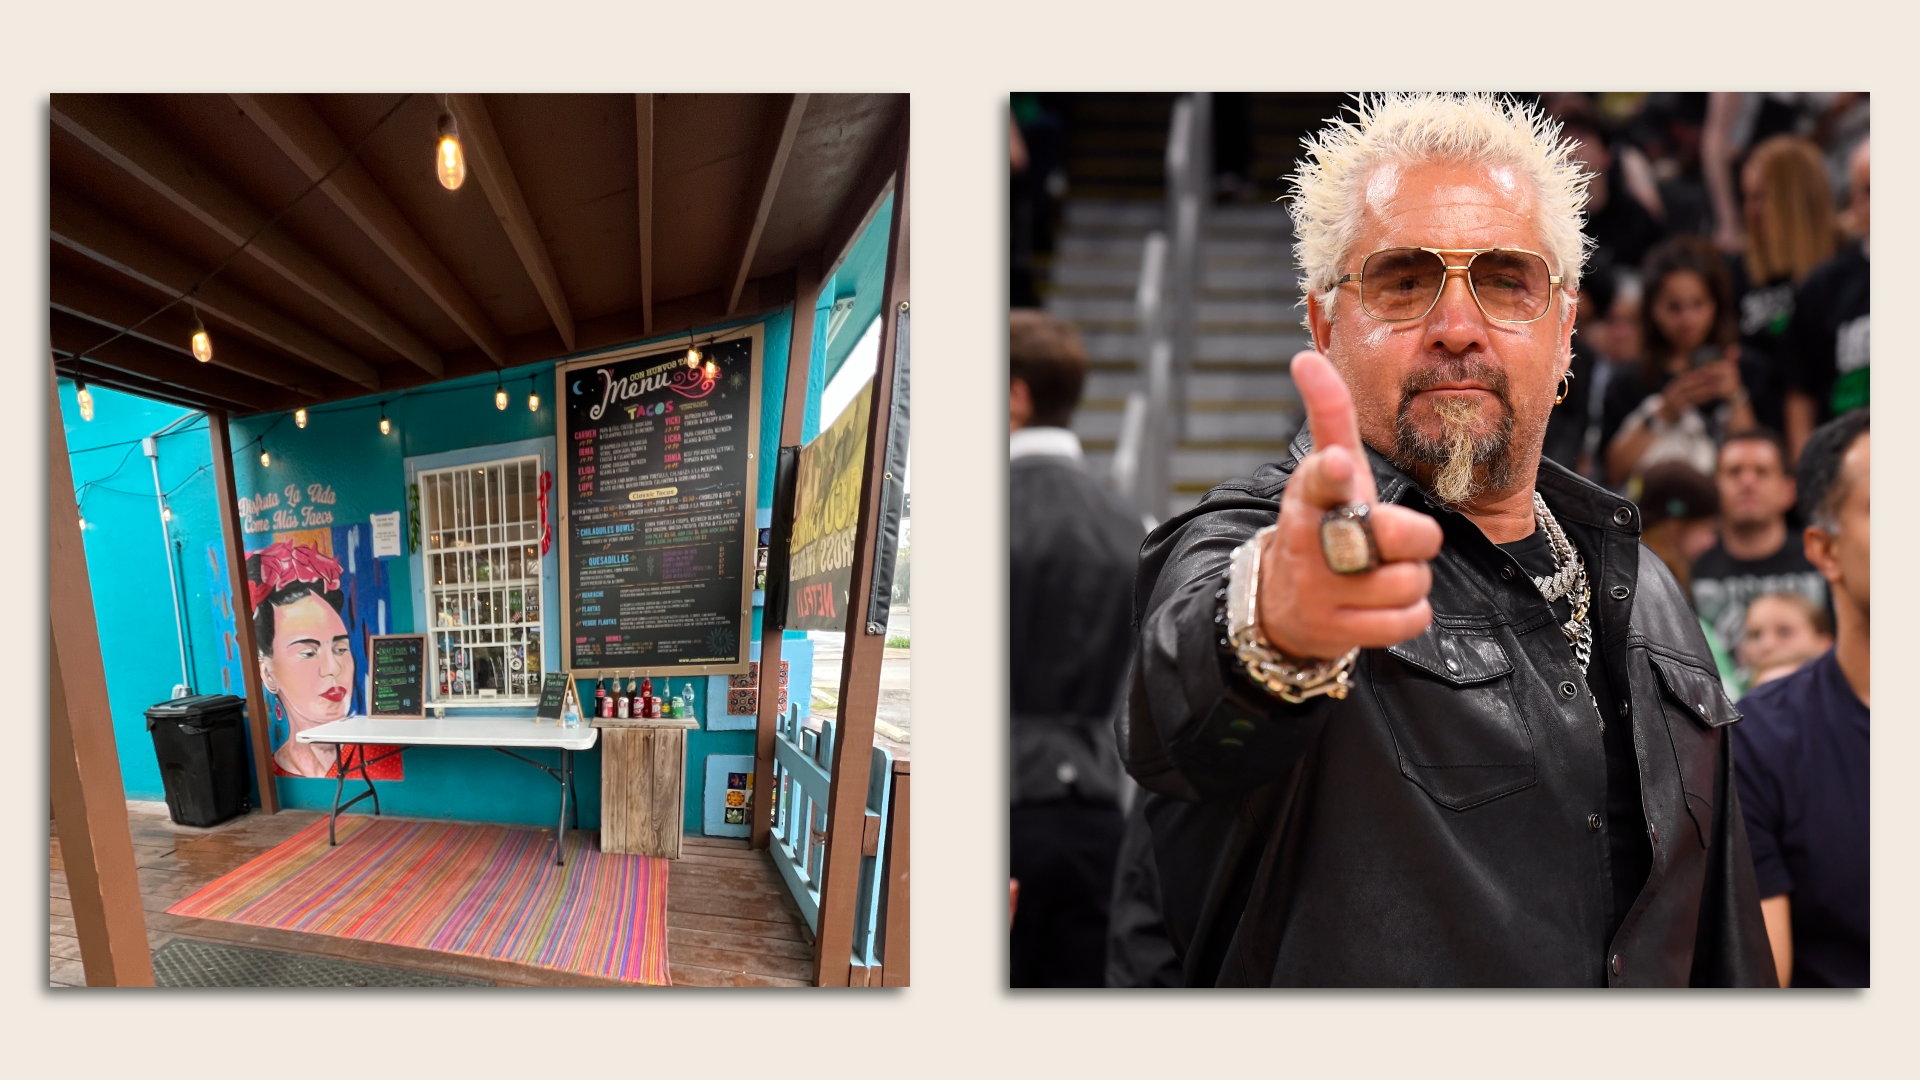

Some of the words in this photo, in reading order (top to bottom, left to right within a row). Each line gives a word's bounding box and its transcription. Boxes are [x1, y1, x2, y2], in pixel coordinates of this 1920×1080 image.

[630, 371, 645, 382] CON
[647, 361, 677, 377] HUEVOS
[589, 368, 672, 420] Menu
[628, 400, 673, 420] TACOS
[664, 415, 680, 426] VICKI
[574, 428, 596, 440] CARMEN
[664, 433, 681, 444] LICHA
[663, 452, 681, 463] SONIA
[578, 482, 593, 491] LUPE
[238, 493, 279, 517] Disfruta
[284, 483, 301, 507] La
[307, 483, 335, 505] Vida
[632, 491, 654, 499] Classic
[656, 488, 674, 496] Tacos
[244, 514, 270, 533] Come
[273, 509, 299, 530] Más
[301, 506, 333, 527] Tacos
[580, 525, 614, 536] CHILAQUILES
[615, 523, 634, 533] BOWLS
[588, 553, 629, 566] QUESADILLAS
